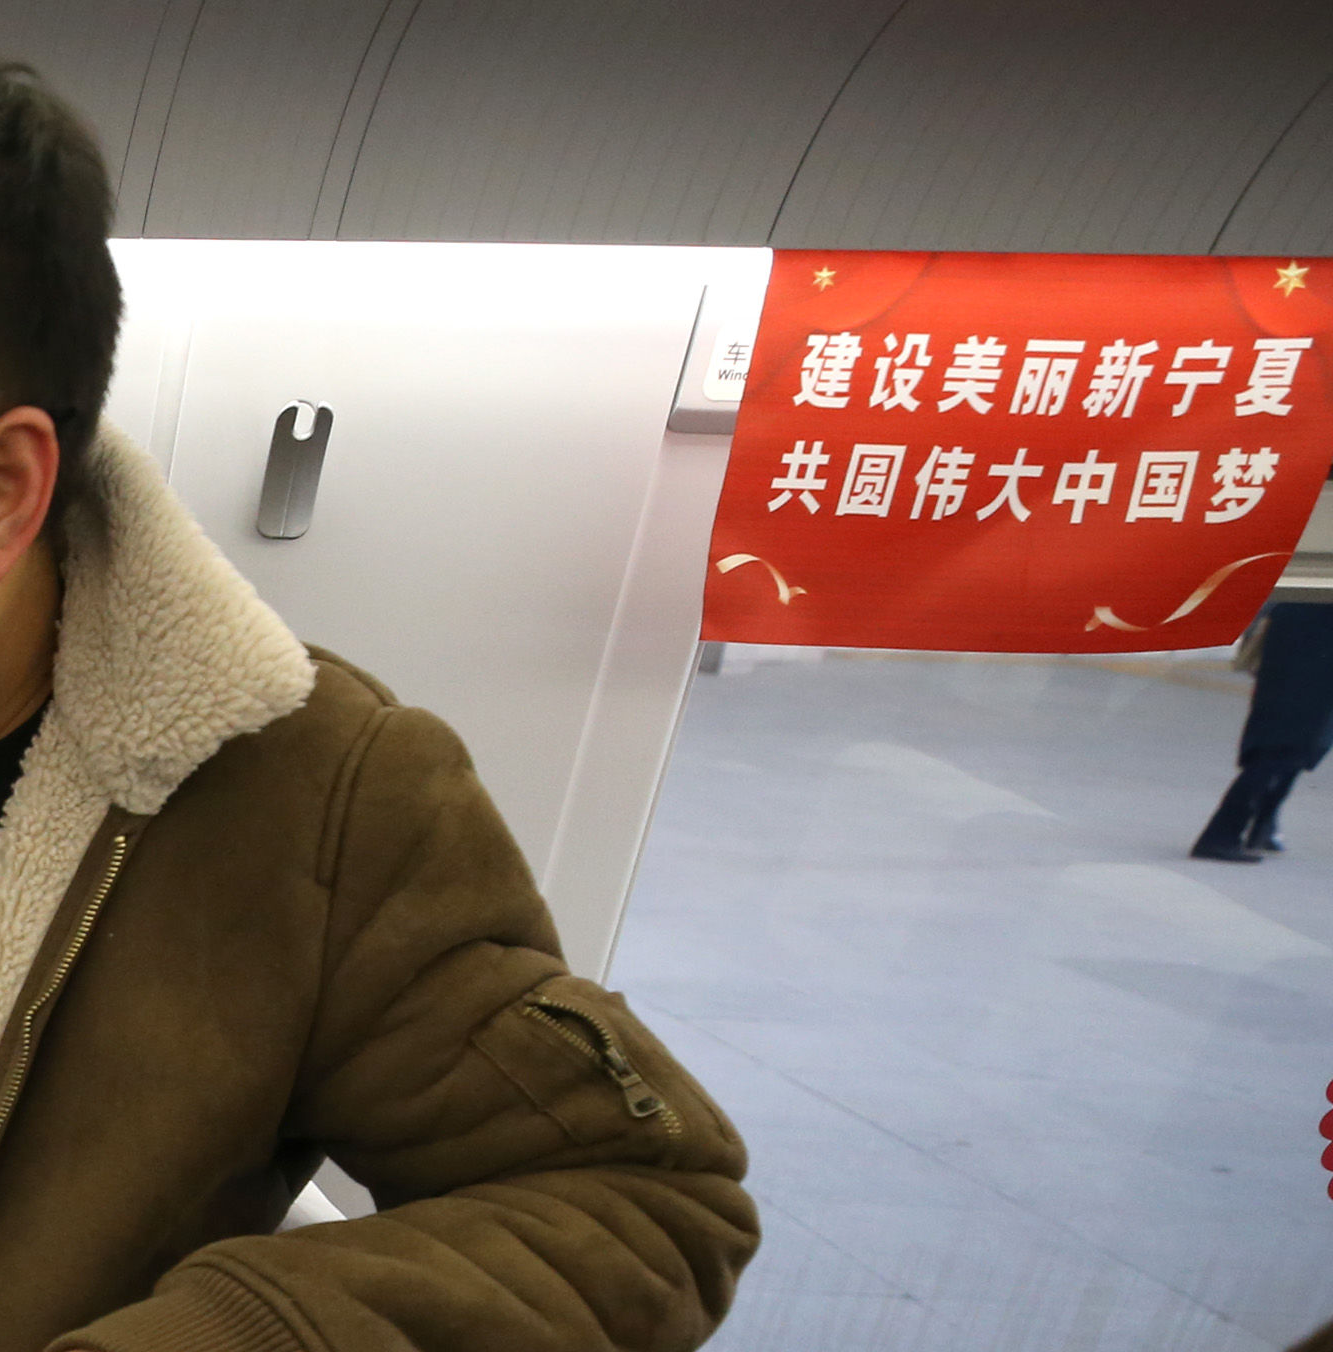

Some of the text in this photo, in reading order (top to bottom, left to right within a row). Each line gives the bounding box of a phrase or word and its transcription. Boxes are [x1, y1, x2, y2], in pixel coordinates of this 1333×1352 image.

[723, 341, 750, 365] 车
[793, 332, 1313, 418] 建设美丽新宁夏
[768, 440, 1281, 524] 共圆伟大中国梦
